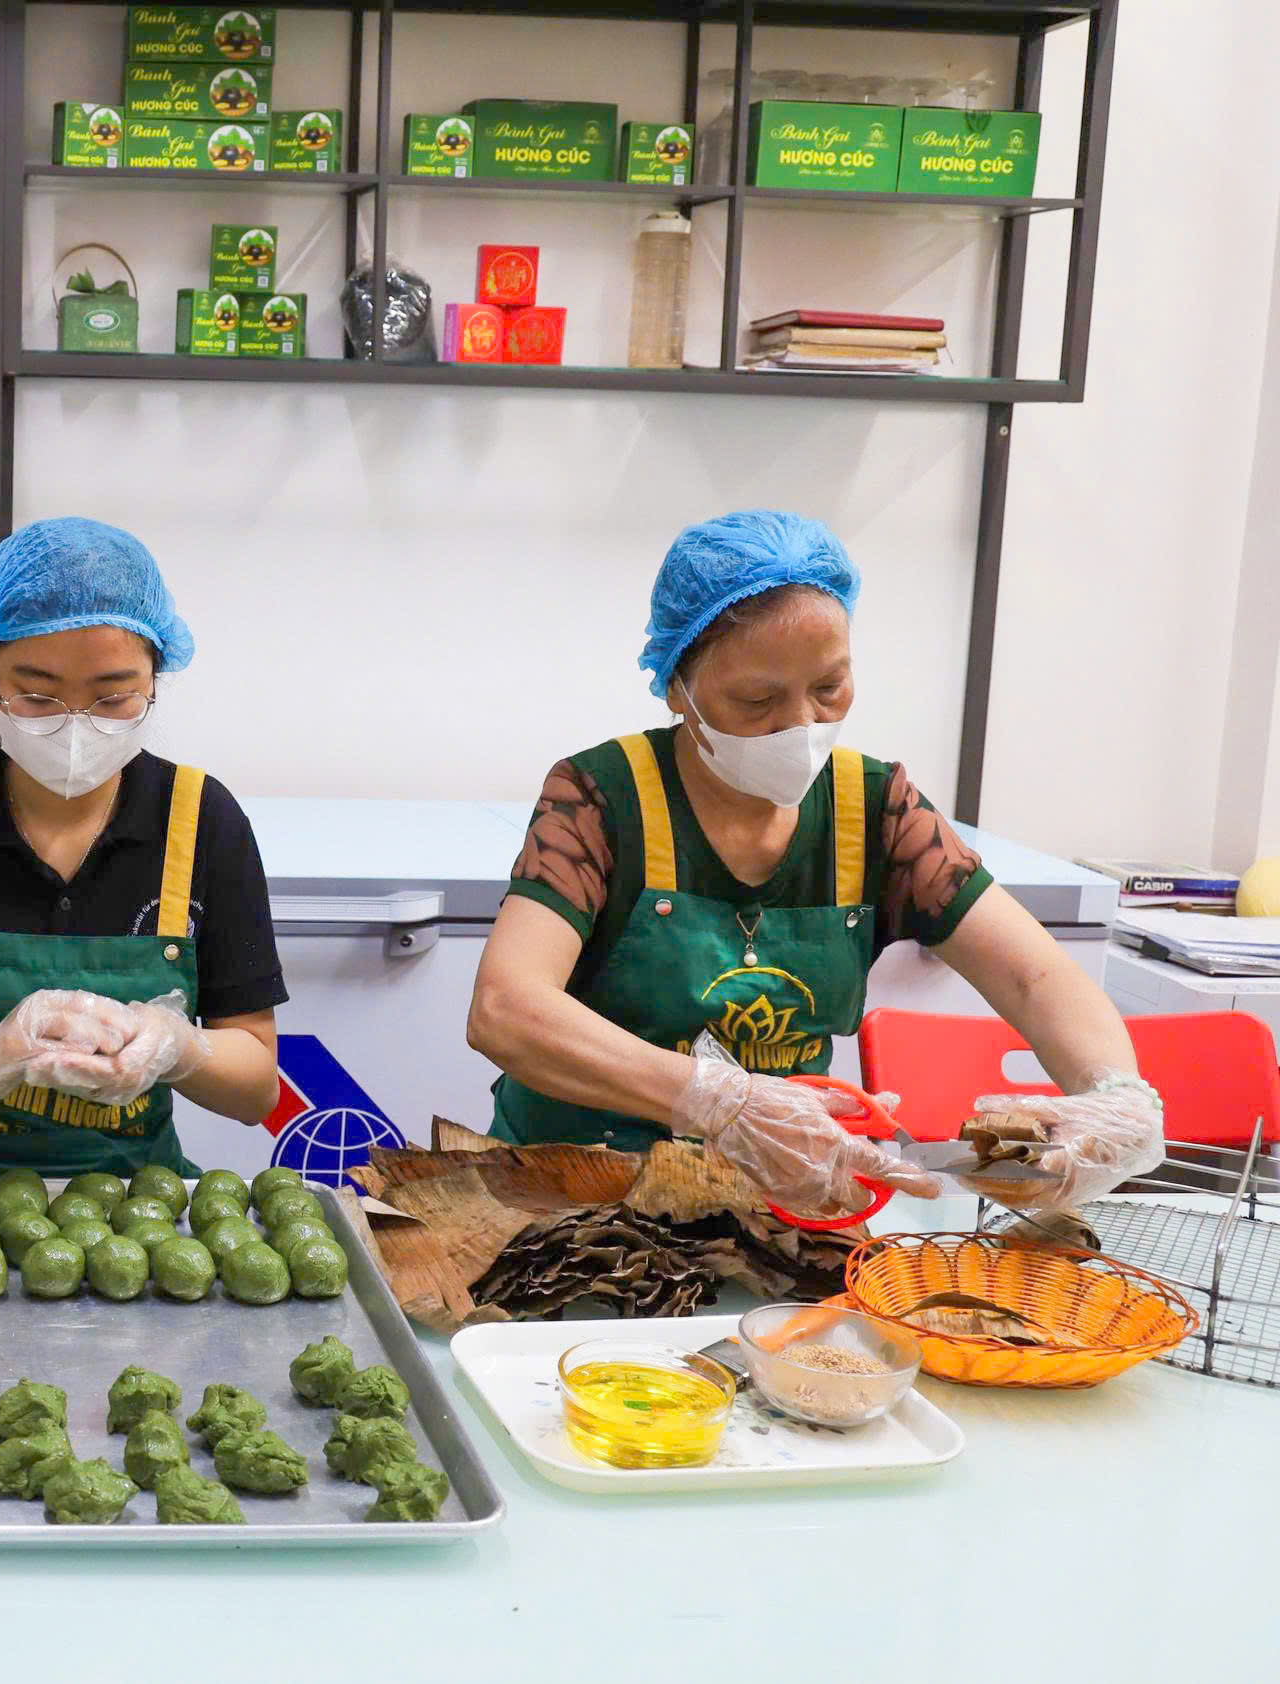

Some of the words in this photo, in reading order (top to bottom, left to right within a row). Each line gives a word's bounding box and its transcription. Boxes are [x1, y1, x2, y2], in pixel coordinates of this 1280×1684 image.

[486, 121, 535, 137] Bánh
[770, 123, 819, 140] Bánh
[816, 126, 851, 150] Gai
[912, 130, 960, 146] Bánh
[956, 133, 992, 156] Gai
[496, 146, 552, 162] HƯƠNG
[556, 147, 591, 163] CÚC
[780, 149, 836, 165] HƯƠNG
[840, 149, 875, 167] CÚC
[921, 156, 977, 172] HƯƠNG
[980, 156, 1014, 173] CÚC
[1133, 880, 1175, 891] CASIO
